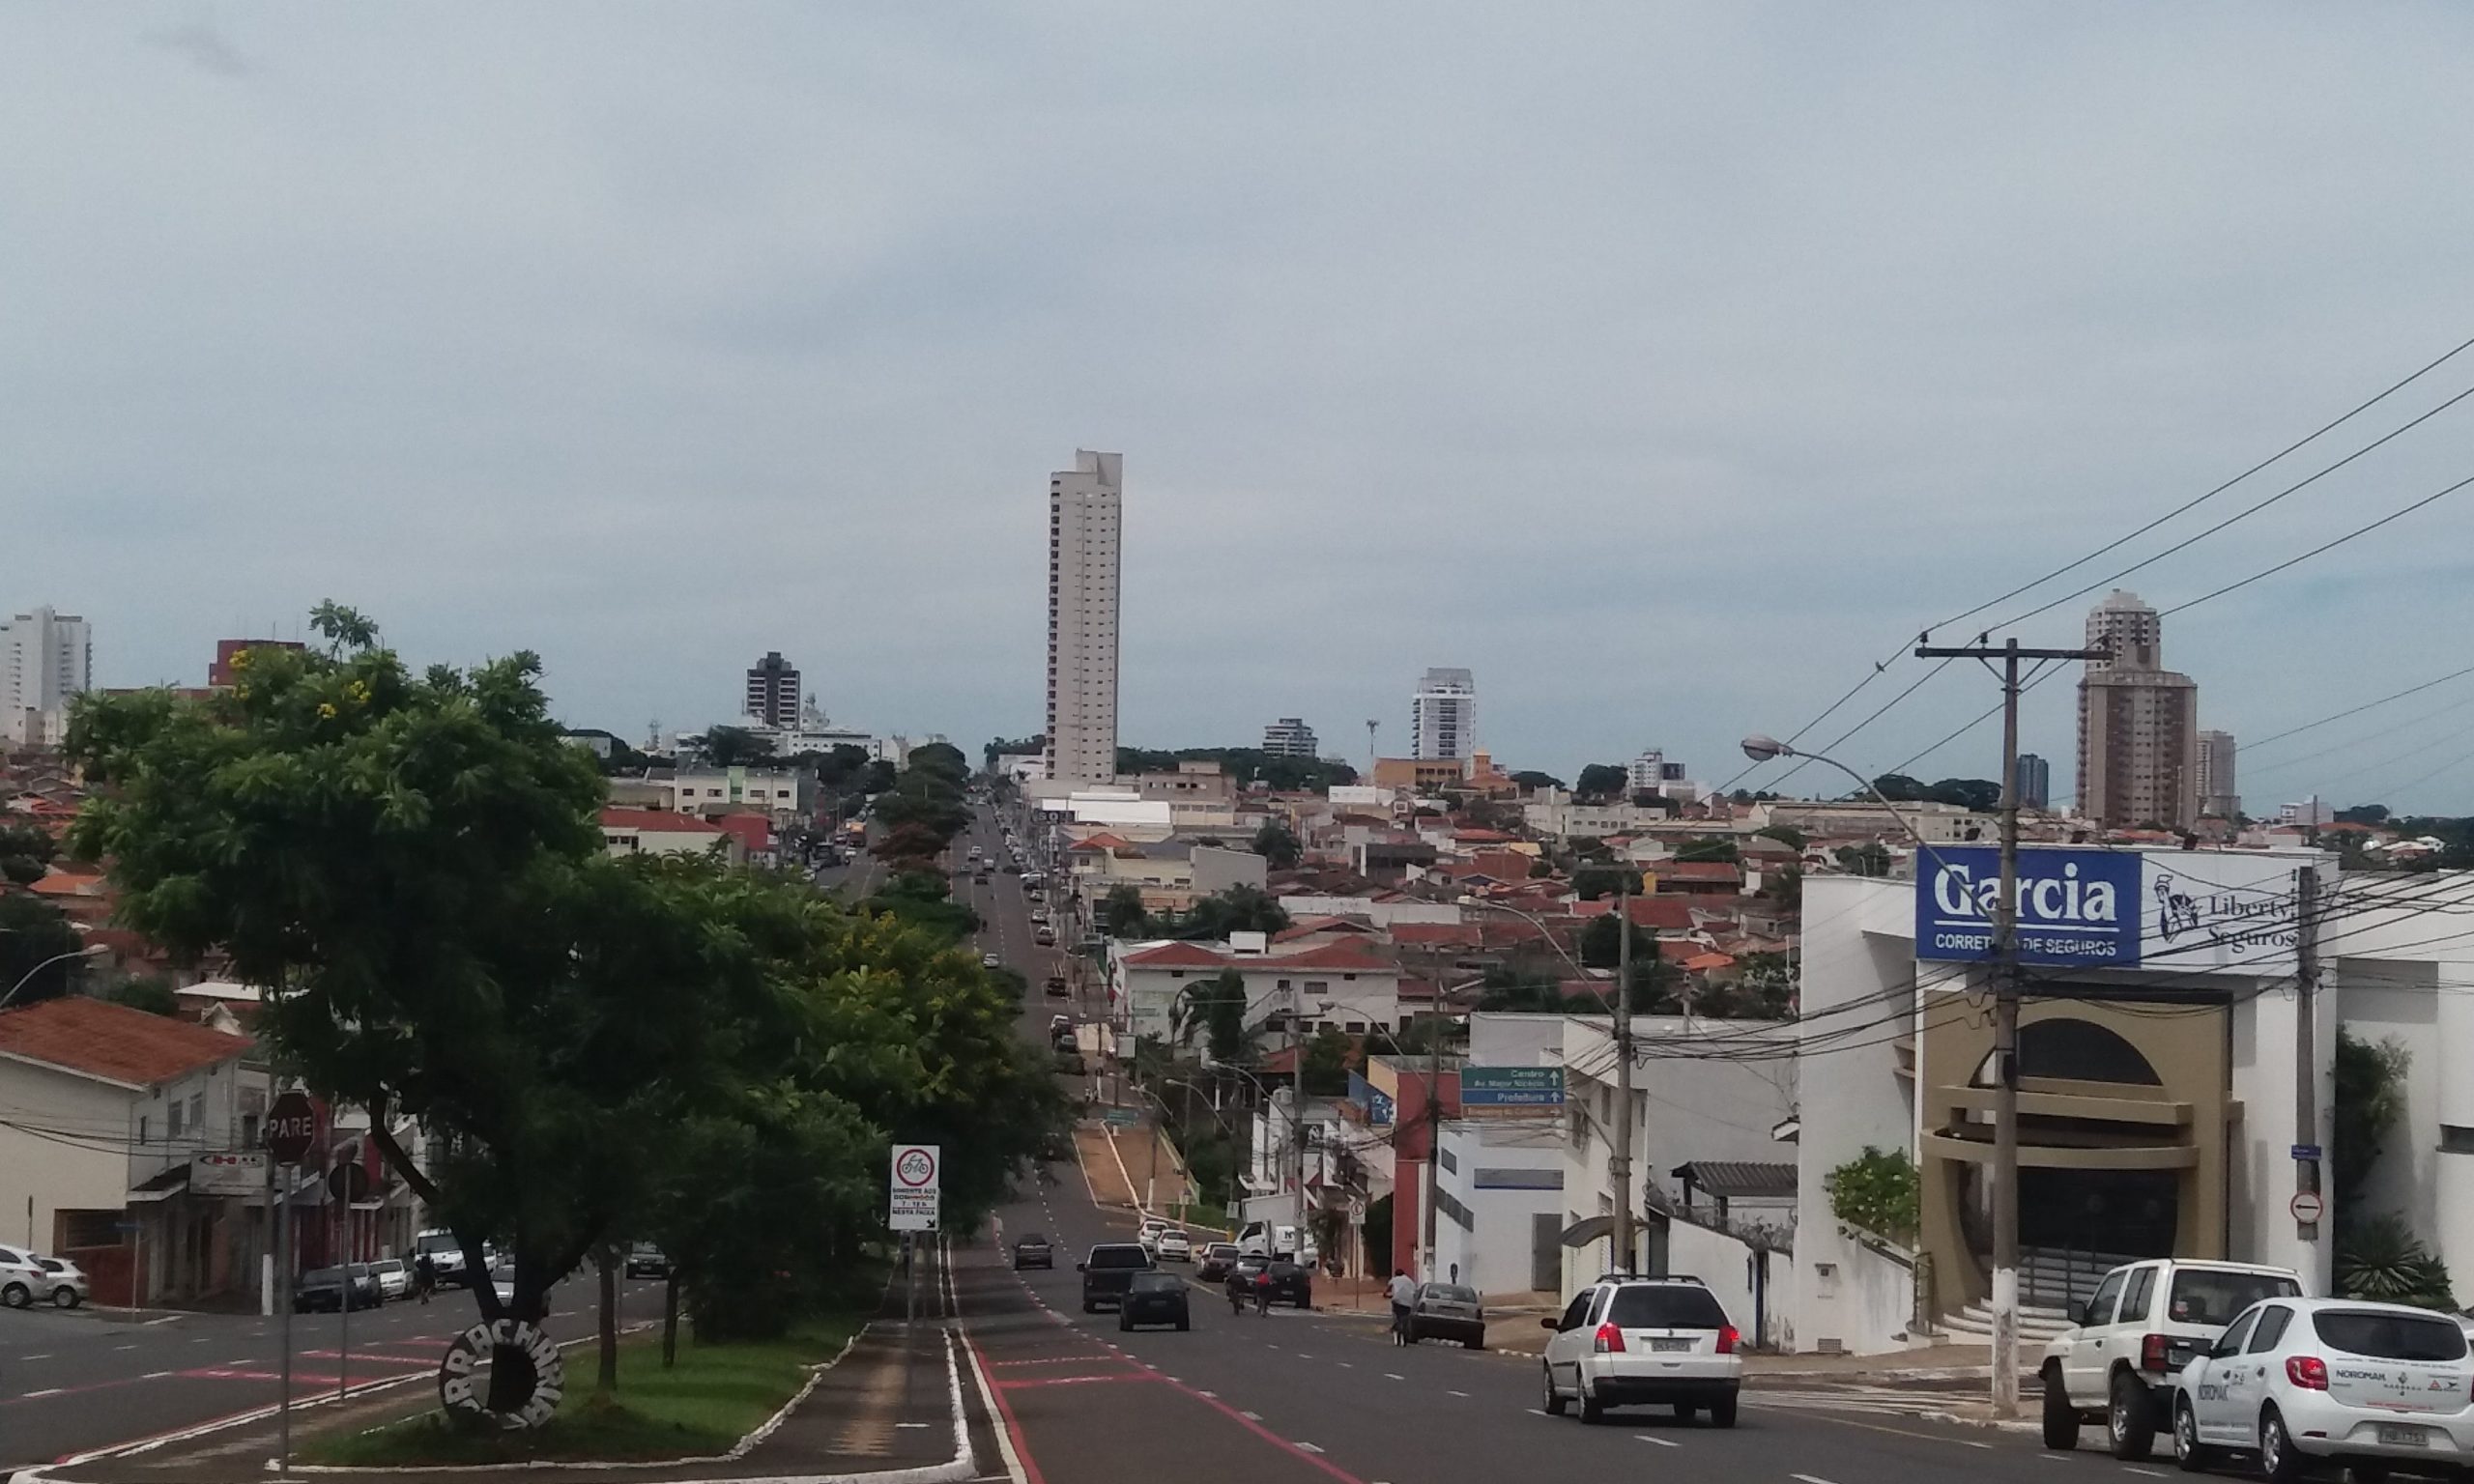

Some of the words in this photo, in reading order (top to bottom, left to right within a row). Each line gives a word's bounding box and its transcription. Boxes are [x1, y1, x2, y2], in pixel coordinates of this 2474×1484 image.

[1934, 863, 2117, 921] Garcia
[2209, 895, 2288, 921] Liberty
[1936, 933, 2019, 952] CORRET
[2024, 937, 2043, 954] DE
[2045, 937, 2116, 956] SEGUROS
[2208, 927, 2297, 954] Seguros
[1510, 1070, 1545, 1078] Centro
[1497, 1092, 1545, 1102] Prefeitura
[270, 1116, 312, 1139] PARE
